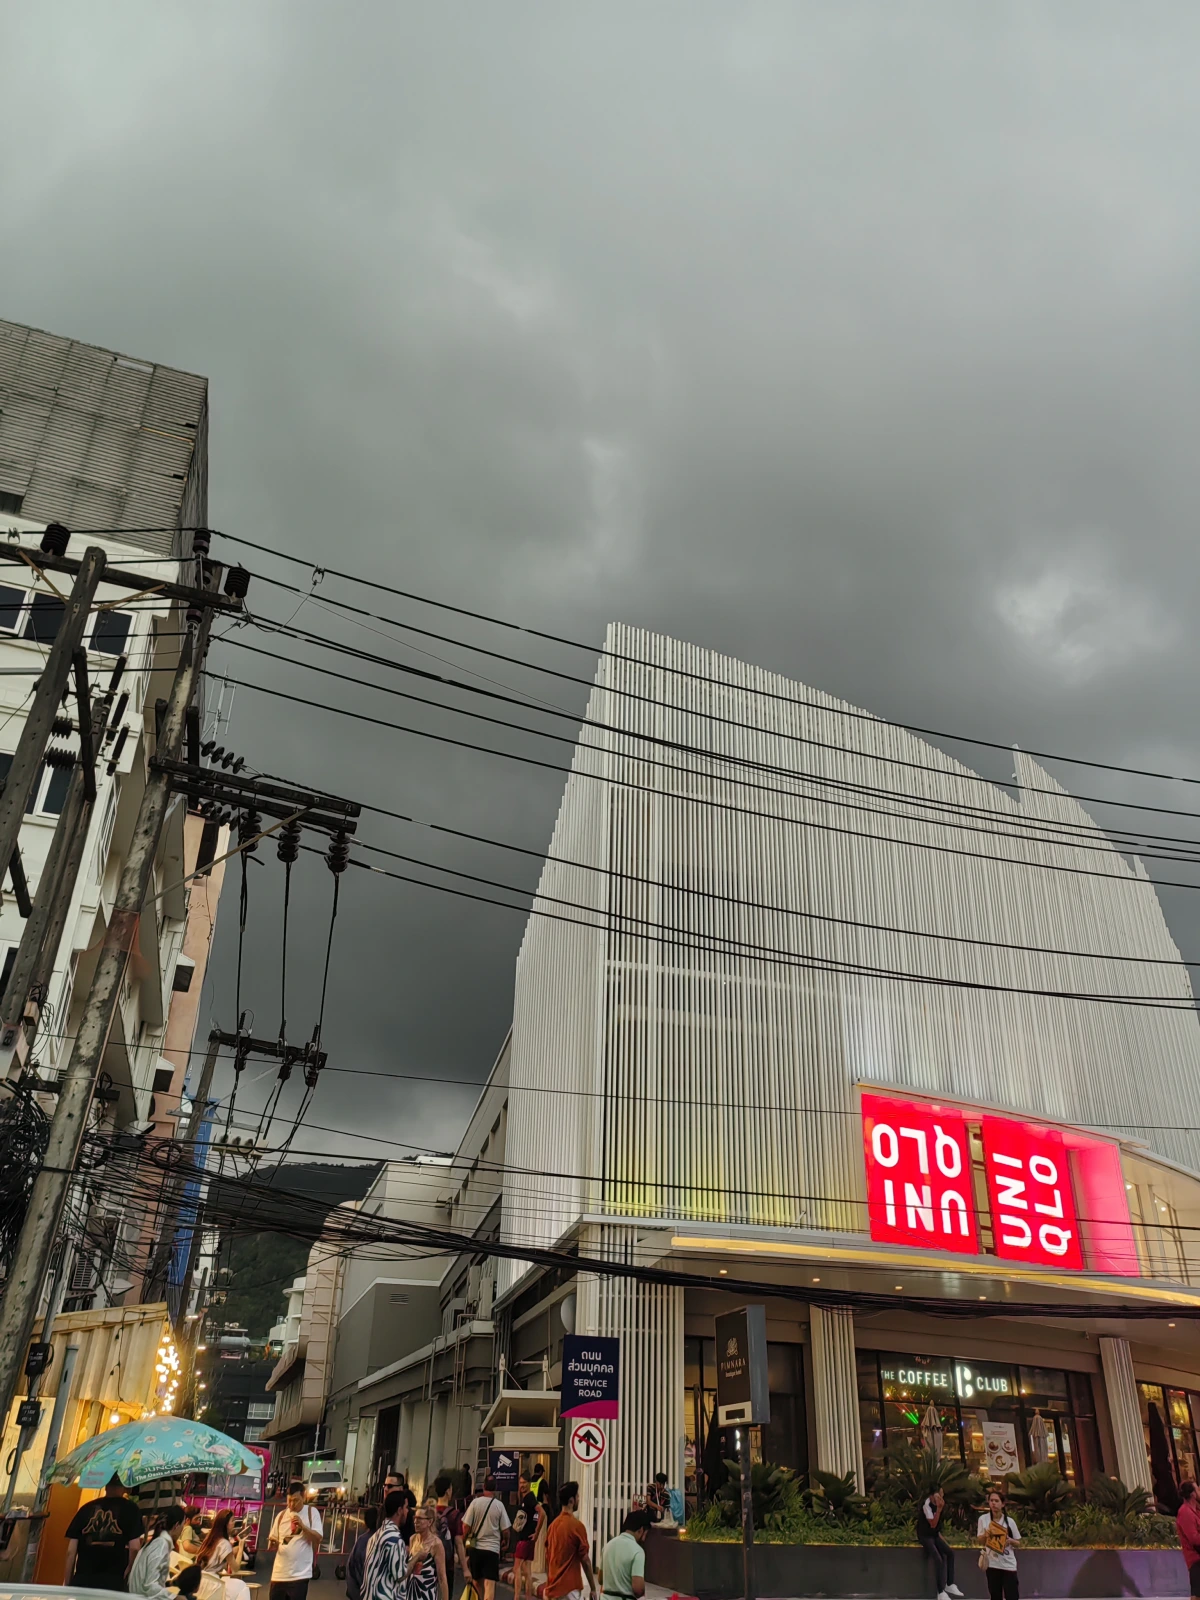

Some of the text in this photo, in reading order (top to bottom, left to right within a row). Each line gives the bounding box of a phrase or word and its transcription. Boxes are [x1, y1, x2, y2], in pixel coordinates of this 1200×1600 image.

[871, 1123, 962, 1179] QLO
[884, 1178, 970, 1237] UNI
[992, 1153, 1033, 1248] UNI
[1029, 1154, 1072, 1257] QLO
[581, 1351, 602, 1361] ถนน
[720, 1357, 746, 1371] PIMNARA
[567, 1358, 614, 1376] ส่วนบุคคล
[573, 1378, 608, 1388] SERVICE
[881, 1369, 1008, 1392] THE COFFEE CLUB
[578, 1389, 602, 1398] ROAD
[143, 1461, 215, 1473] JUNGCEYLON
[135, 1474, 147, 1482] The
